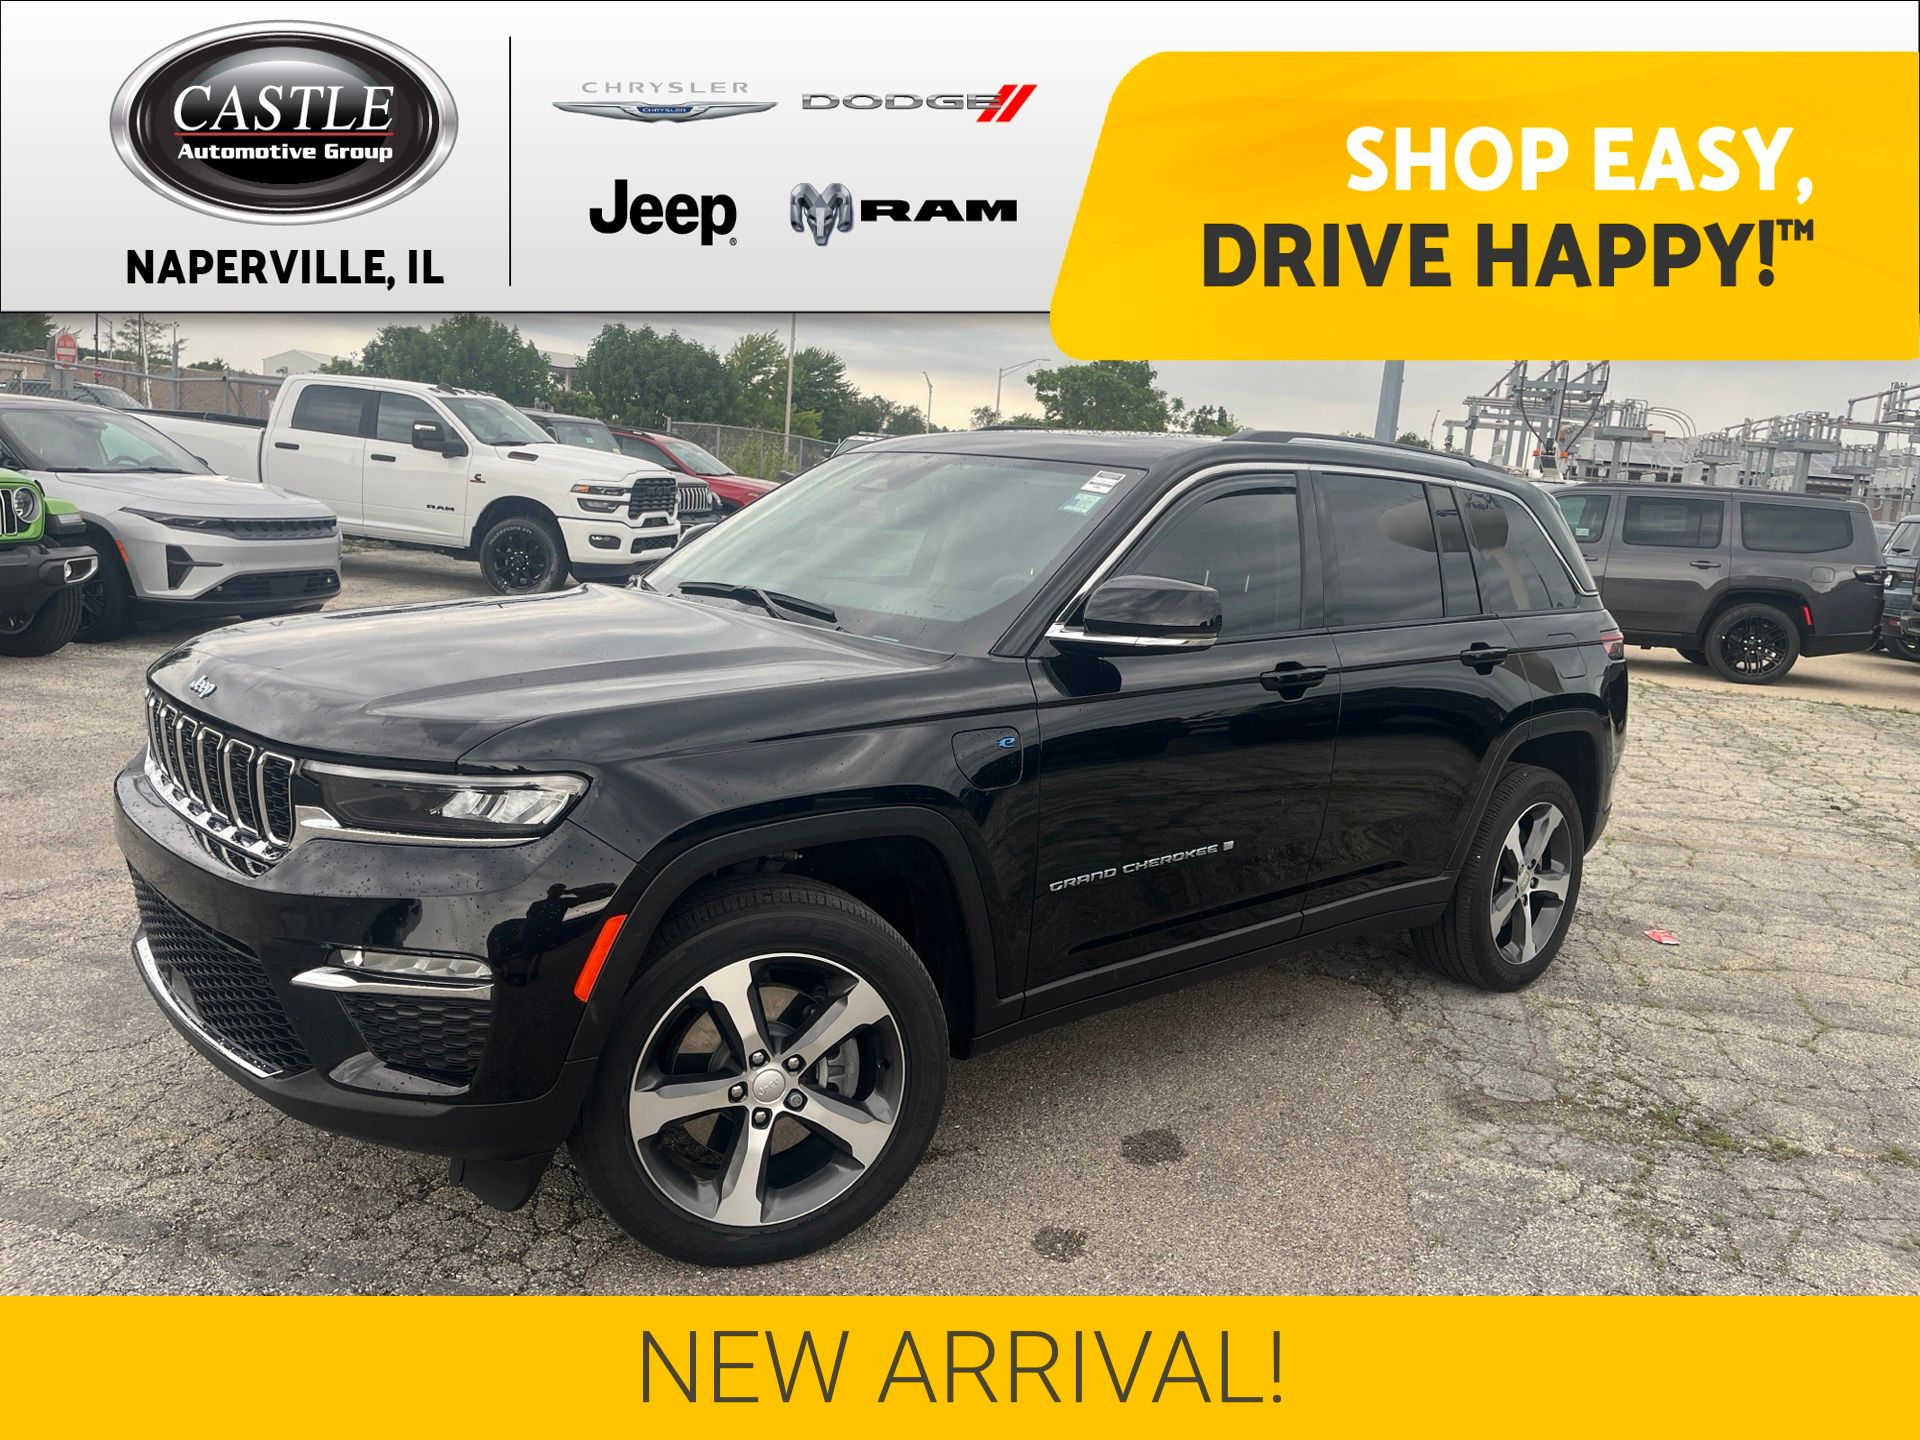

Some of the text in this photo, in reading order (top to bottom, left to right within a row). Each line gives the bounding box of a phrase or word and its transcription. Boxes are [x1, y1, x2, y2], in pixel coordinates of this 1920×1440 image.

[426, 504, 455, 512] RAM
[189, 674, 217, 699] Jeep
[1049, 843, 1219, 893] GRAND CHEROKEE
